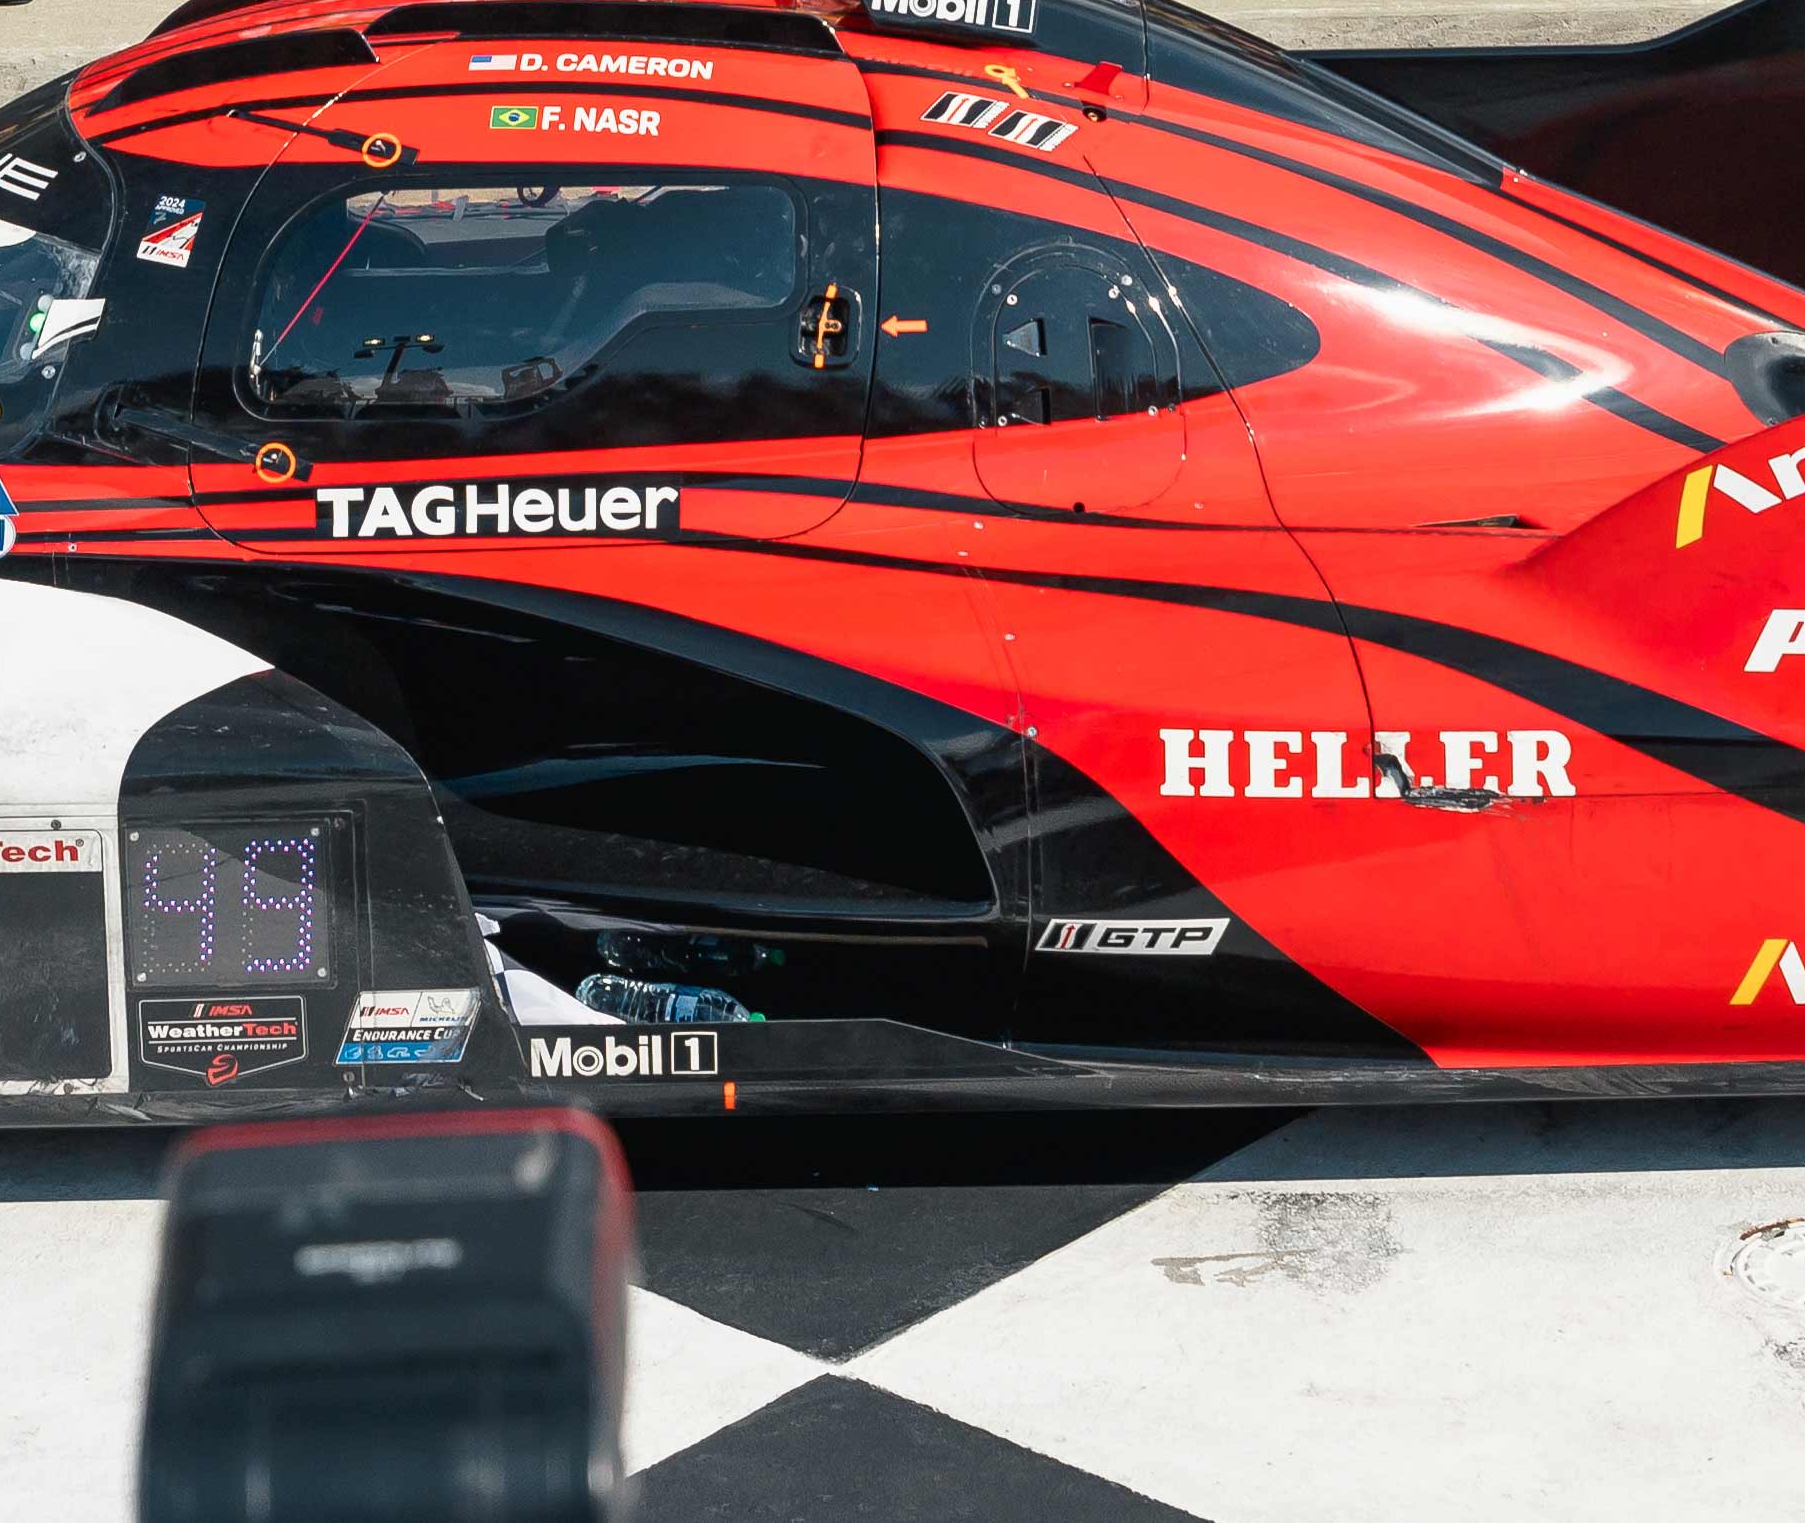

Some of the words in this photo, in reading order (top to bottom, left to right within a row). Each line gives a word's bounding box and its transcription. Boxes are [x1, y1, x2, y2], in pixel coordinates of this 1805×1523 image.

[520, 53, 549, 73] D.
[556, 55, 714, 80] CAMERON
[541, 109, 565, 131] F.
[573, 108, 661, 136] NASR
[159, 195, 186, 208] 2024
[1159, 728, 1577, 798] HELLER
[1095, 925, 1215, 951] GTP
[209, 1004, 253, 1017] IMSA
[375, 1006, 410, 1017] IMSA
[148, 1023, 297, 1040] WeatherTech
[530, 1033, 663, 1077] Mobil
